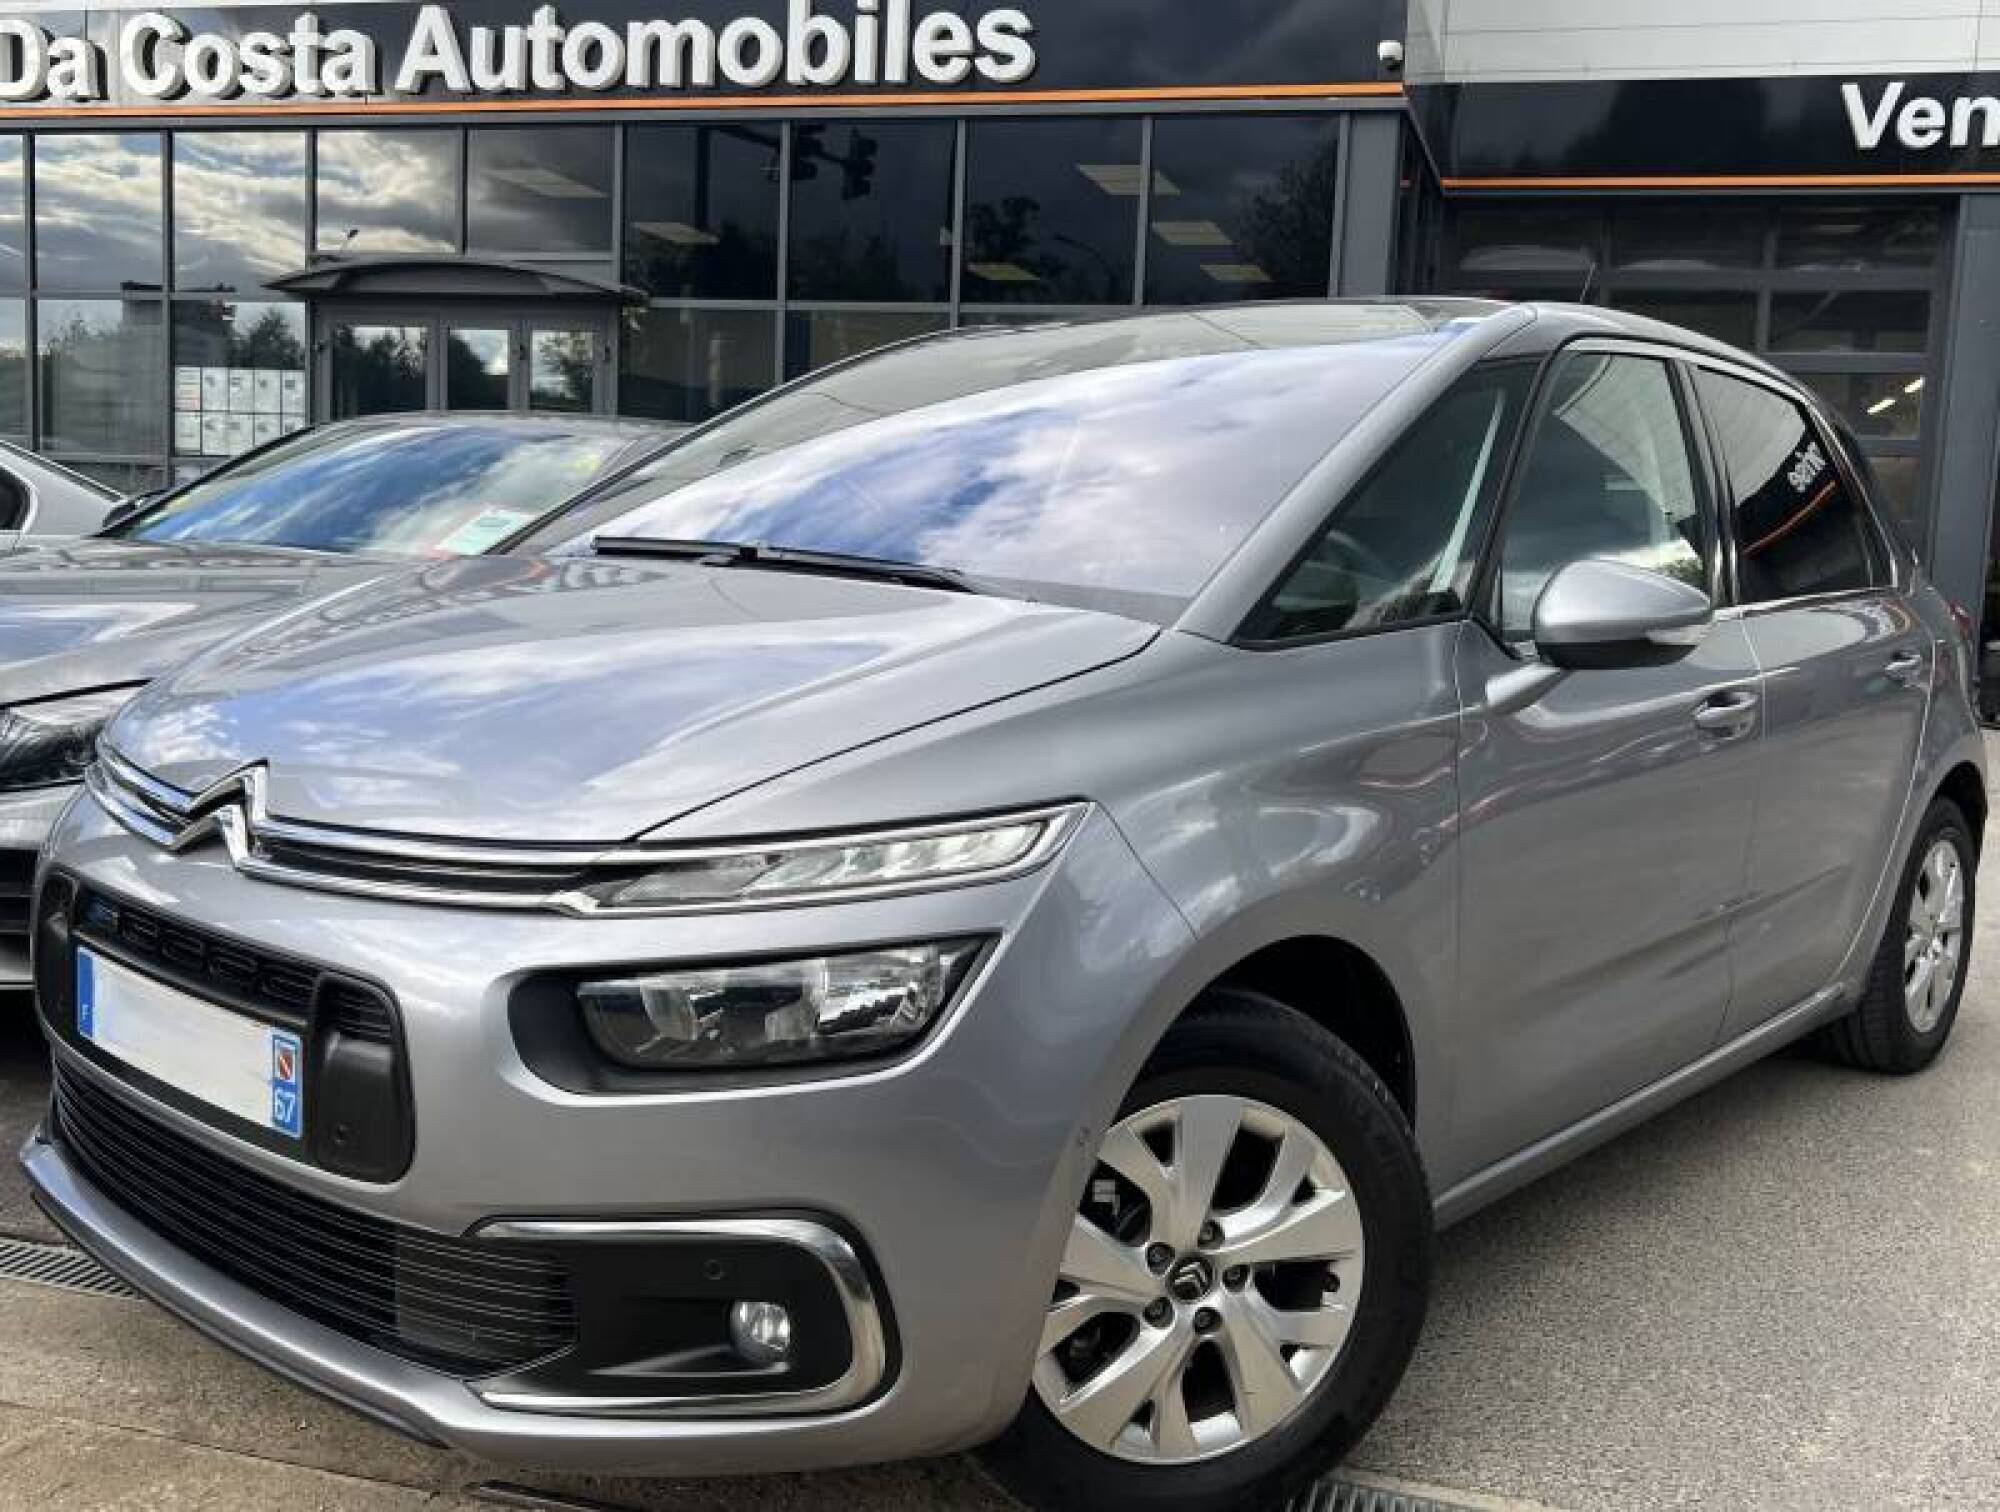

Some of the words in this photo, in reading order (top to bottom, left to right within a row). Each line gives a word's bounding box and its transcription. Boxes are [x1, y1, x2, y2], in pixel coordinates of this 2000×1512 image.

[0, 19, 105, 100] Da
[120, 11, 377, 99] Costa
[394, 0, 1036, 92] Automobiles
[1841, 81, 2000, 149] Ven
[274, 1087, 296, 1123] 67
